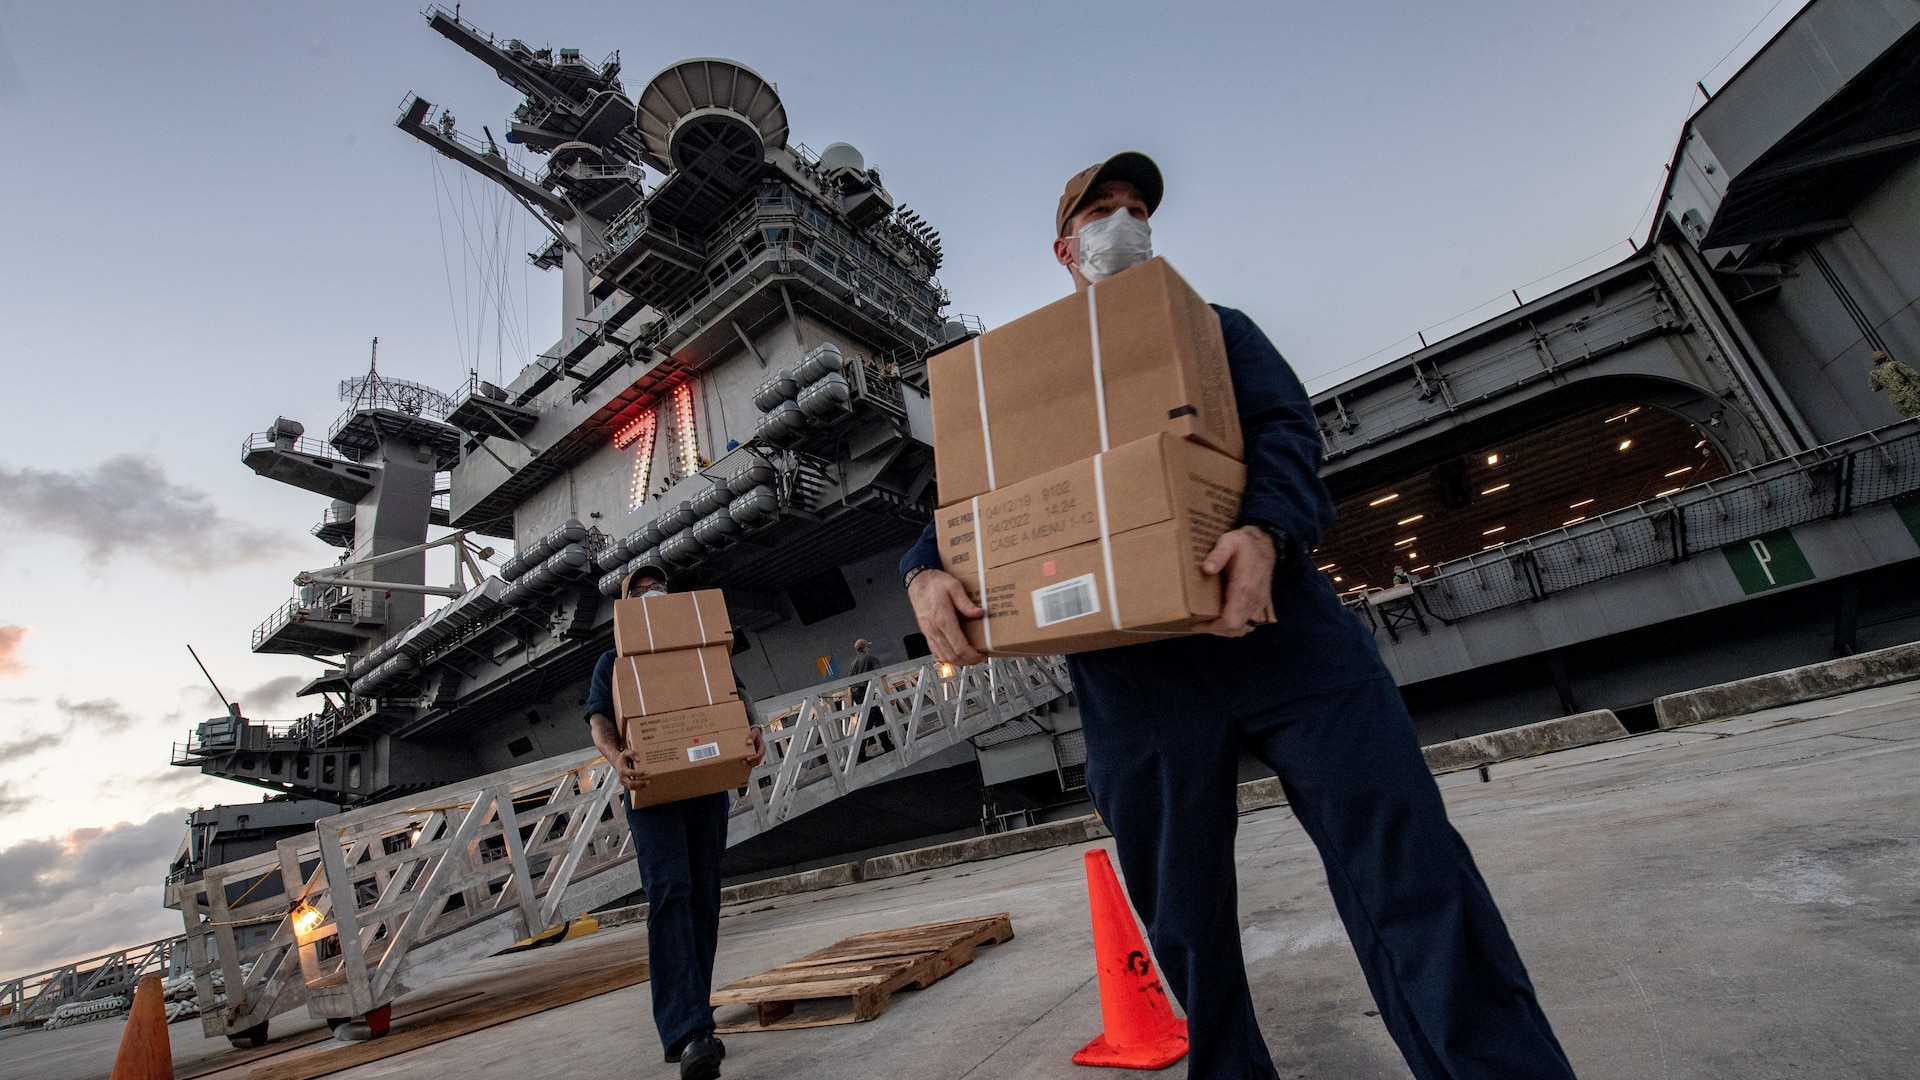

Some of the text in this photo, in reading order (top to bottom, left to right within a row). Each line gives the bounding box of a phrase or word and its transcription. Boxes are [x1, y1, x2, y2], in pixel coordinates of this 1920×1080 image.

[614, 384, 699, 515] 71
[988, 513, 1030, 536] 04/2022
[989, 534, 1018, 552] CASE
[1022, 531, 1030, 542] A
[1032, 519, 1066, 540] MENU
[1749, 539, 1776, 585] P
